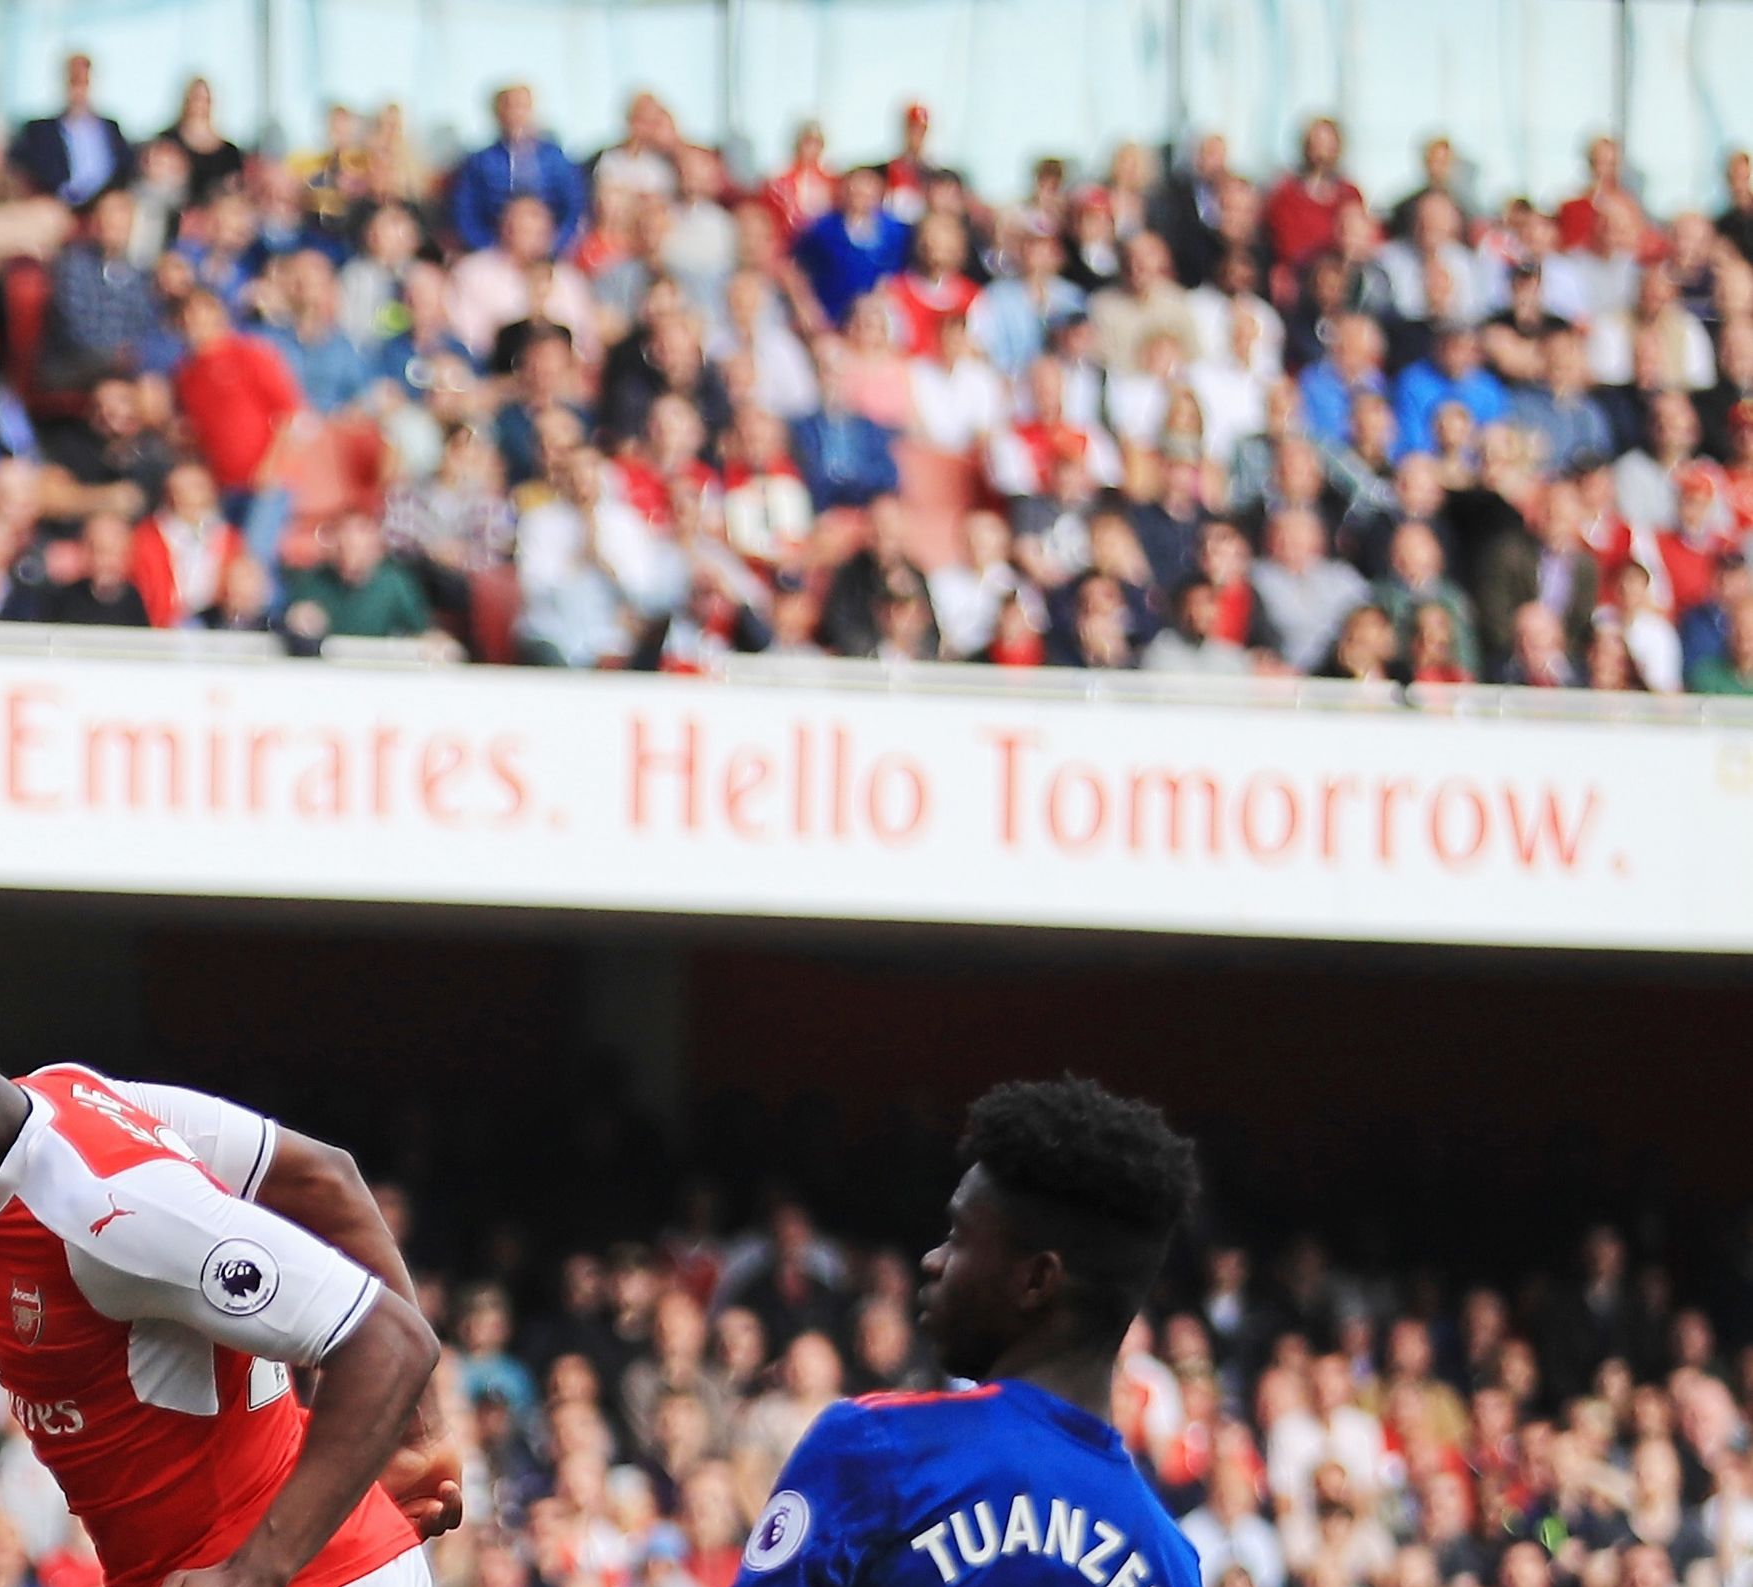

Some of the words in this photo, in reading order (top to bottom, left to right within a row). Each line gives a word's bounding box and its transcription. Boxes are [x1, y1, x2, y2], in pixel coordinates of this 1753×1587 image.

[2, 685, 572, 830] Emirates.
[624, 710, 932, 846] Hello
[980, 728, 1634, 878] Tomorrow.
